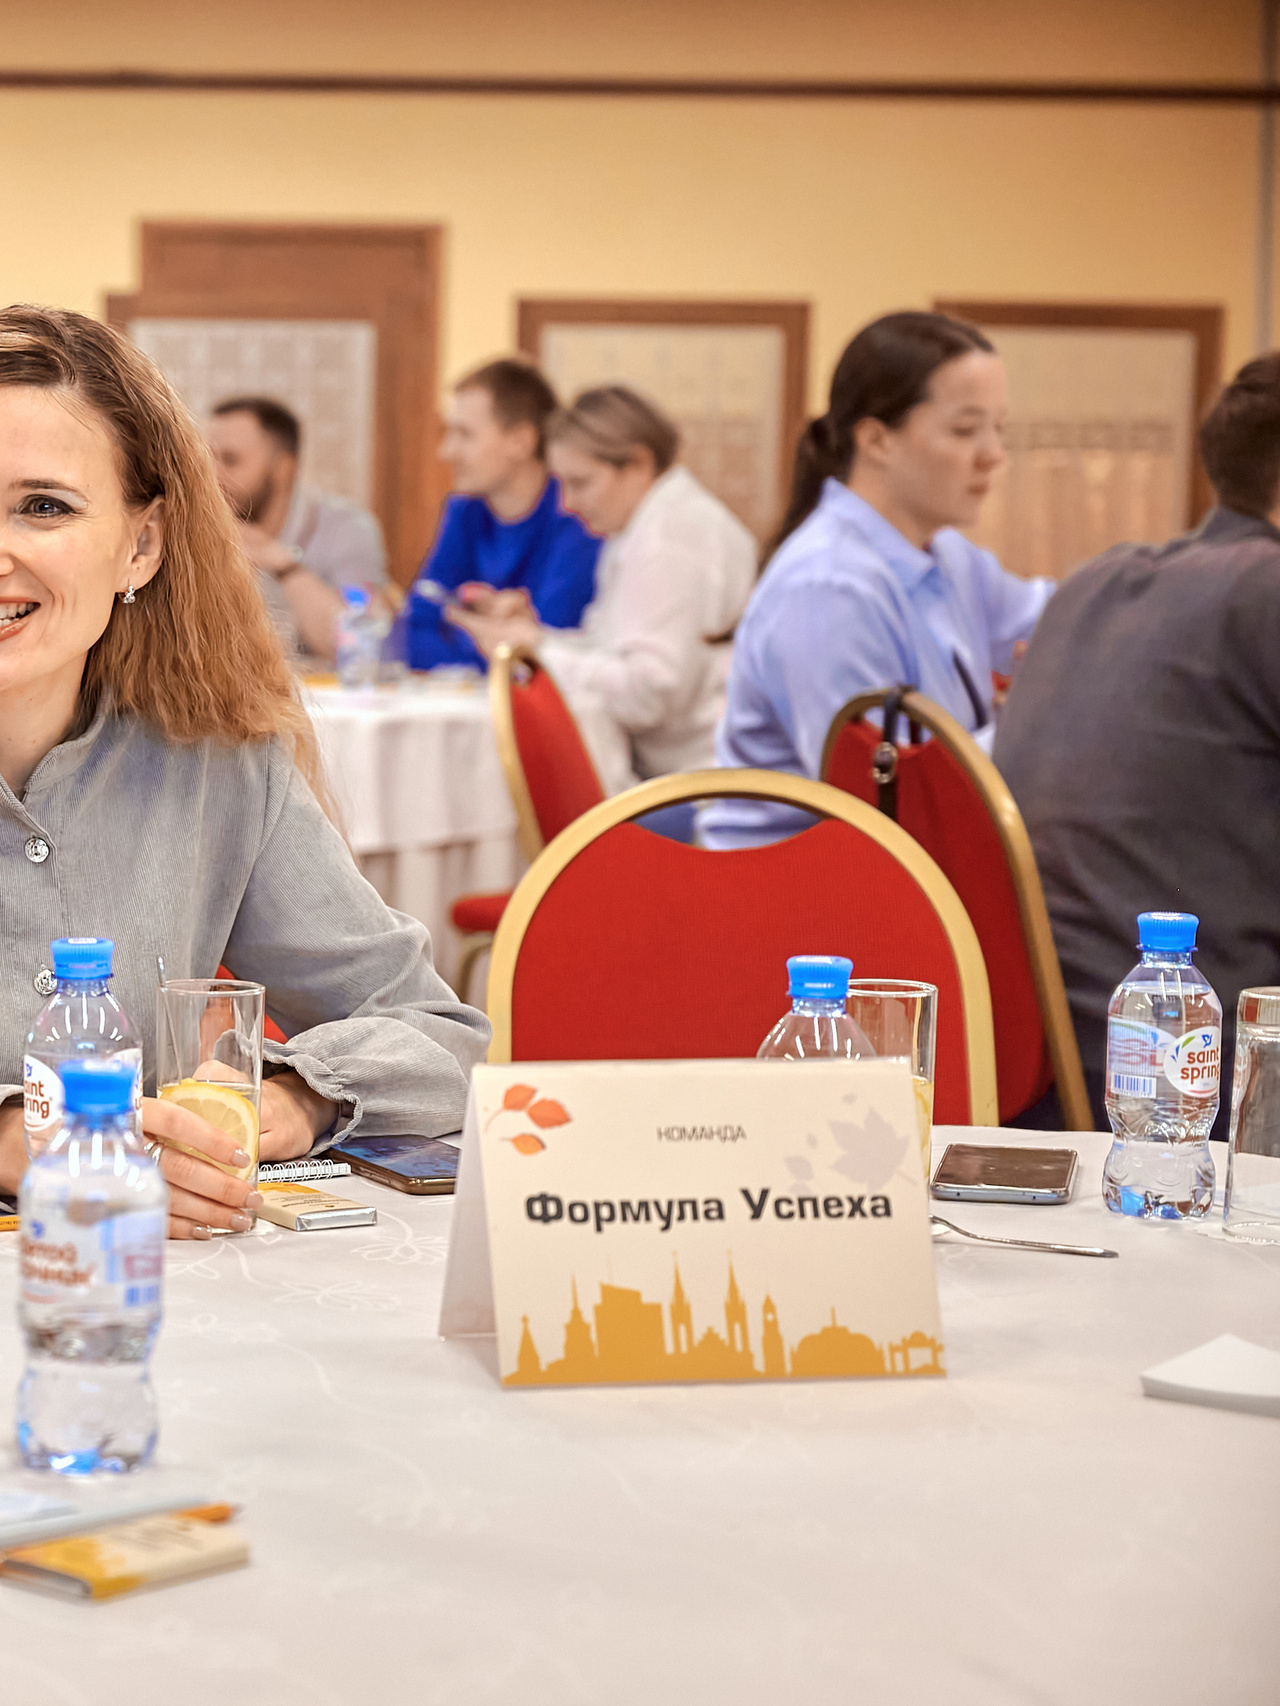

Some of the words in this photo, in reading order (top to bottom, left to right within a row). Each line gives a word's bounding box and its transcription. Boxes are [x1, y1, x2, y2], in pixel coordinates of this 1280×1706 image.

[24, 1096, 50, 1119] ring
[656, 1125, 747, 1144] КОМАНДА
[526, 1192, 726, 1233] Формула
[740, 1187, 893, 1221] Успеха
